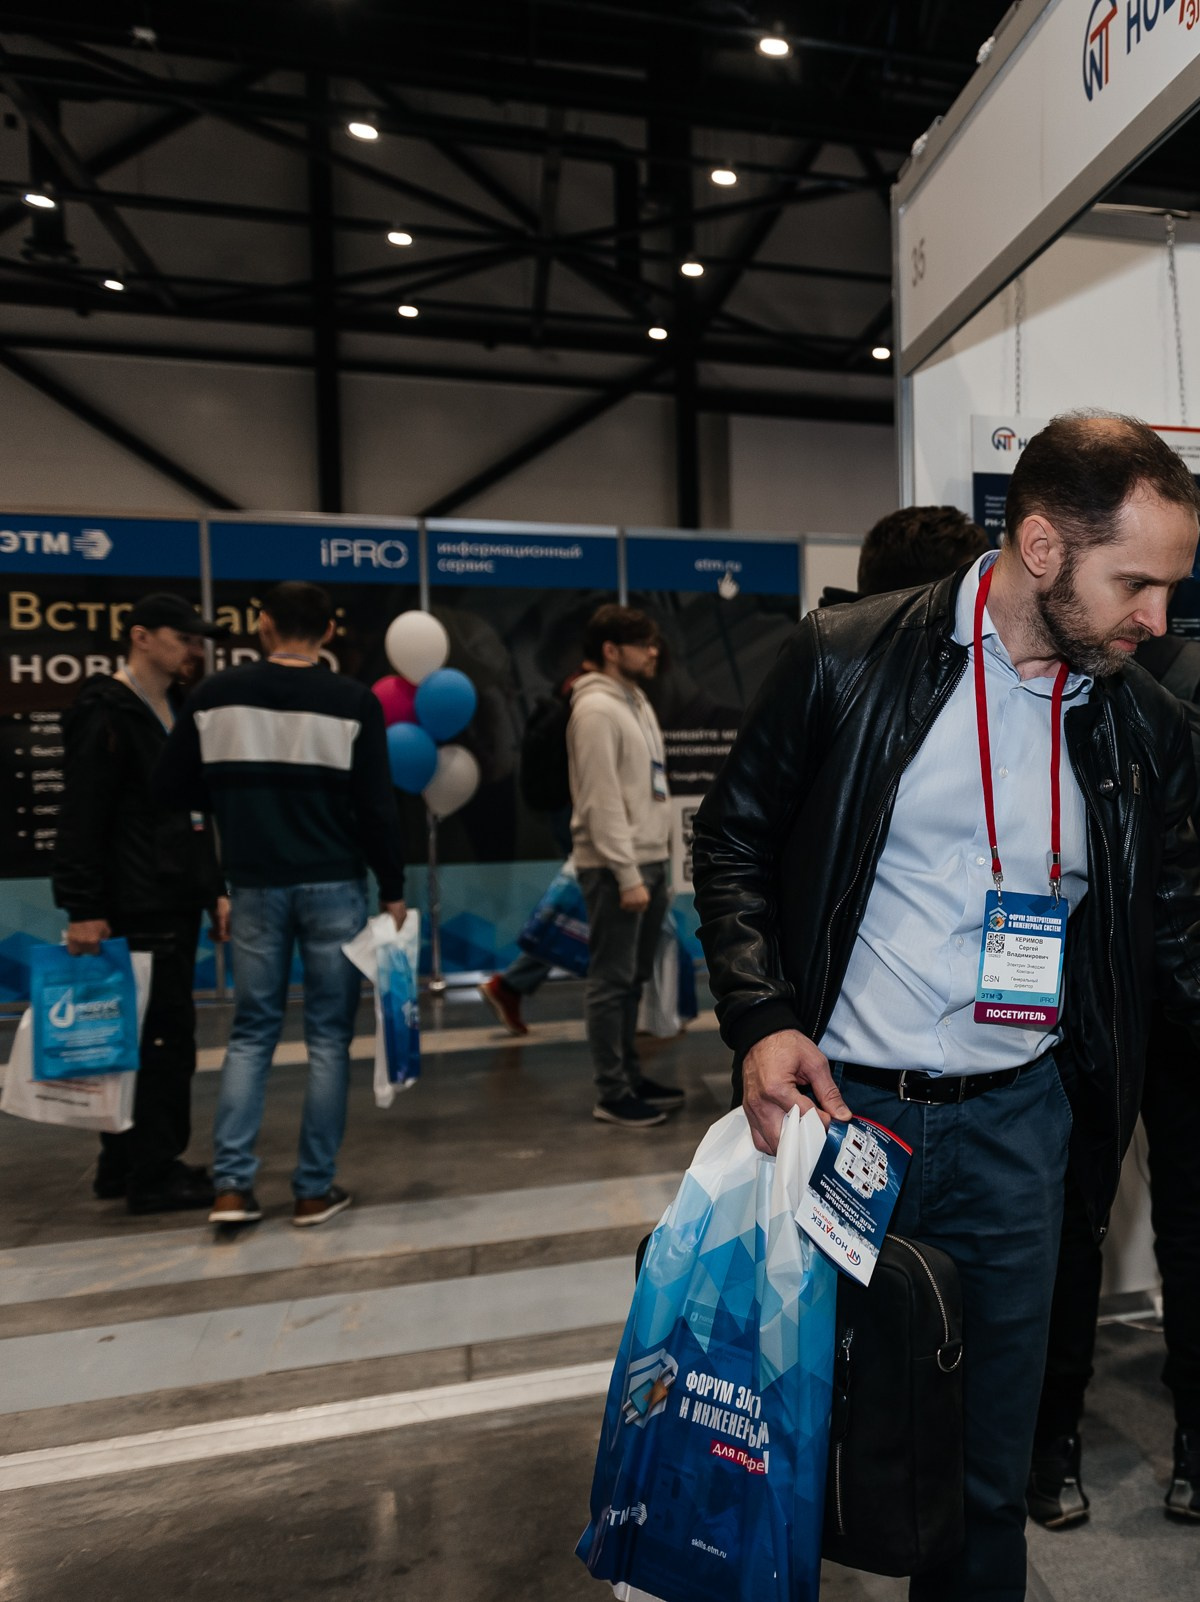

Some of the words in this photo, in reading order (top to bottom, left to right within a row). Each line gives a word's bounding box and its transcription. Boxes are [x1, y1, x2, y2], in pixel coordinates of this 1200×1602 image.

[0, 530, 70, 555] ЭТМ
[437, 541, 583, 559] информационный
[320, 538, 409, 568] iPRO
[437, 558, 495, 574] сервис
[694, 558, 742, 573] etm.ru
[1008, 914, 1026, 922] ФОРУМ
[1006, 951, 1049, 961] Владимирович
[1018, 944, 1039, 953] Сергей
[983, 974, 1000, 983] CSN
[980, 992, 995, 1000] ЭТМ
[986, 1008, 1047, 1021] ПОСЕТИТЕЛЬ
[820, 1179, 860, 1219] НАПРЯЖЕНИЯ
[824, 1191, 866, 1233] ОДНОФАЗНЫЕ
[810, 1212, 848, 1251] НОВАТЕК
[858, 1215, 876, 1234] РЕЛЕ
[685, 1370, 735, 1405] ФОРУМ
[679, 1396, 690, 1419] И
[712, 1443, 735, 1458] для
[691, 1537, 728, 1559] skills.etm.ru
